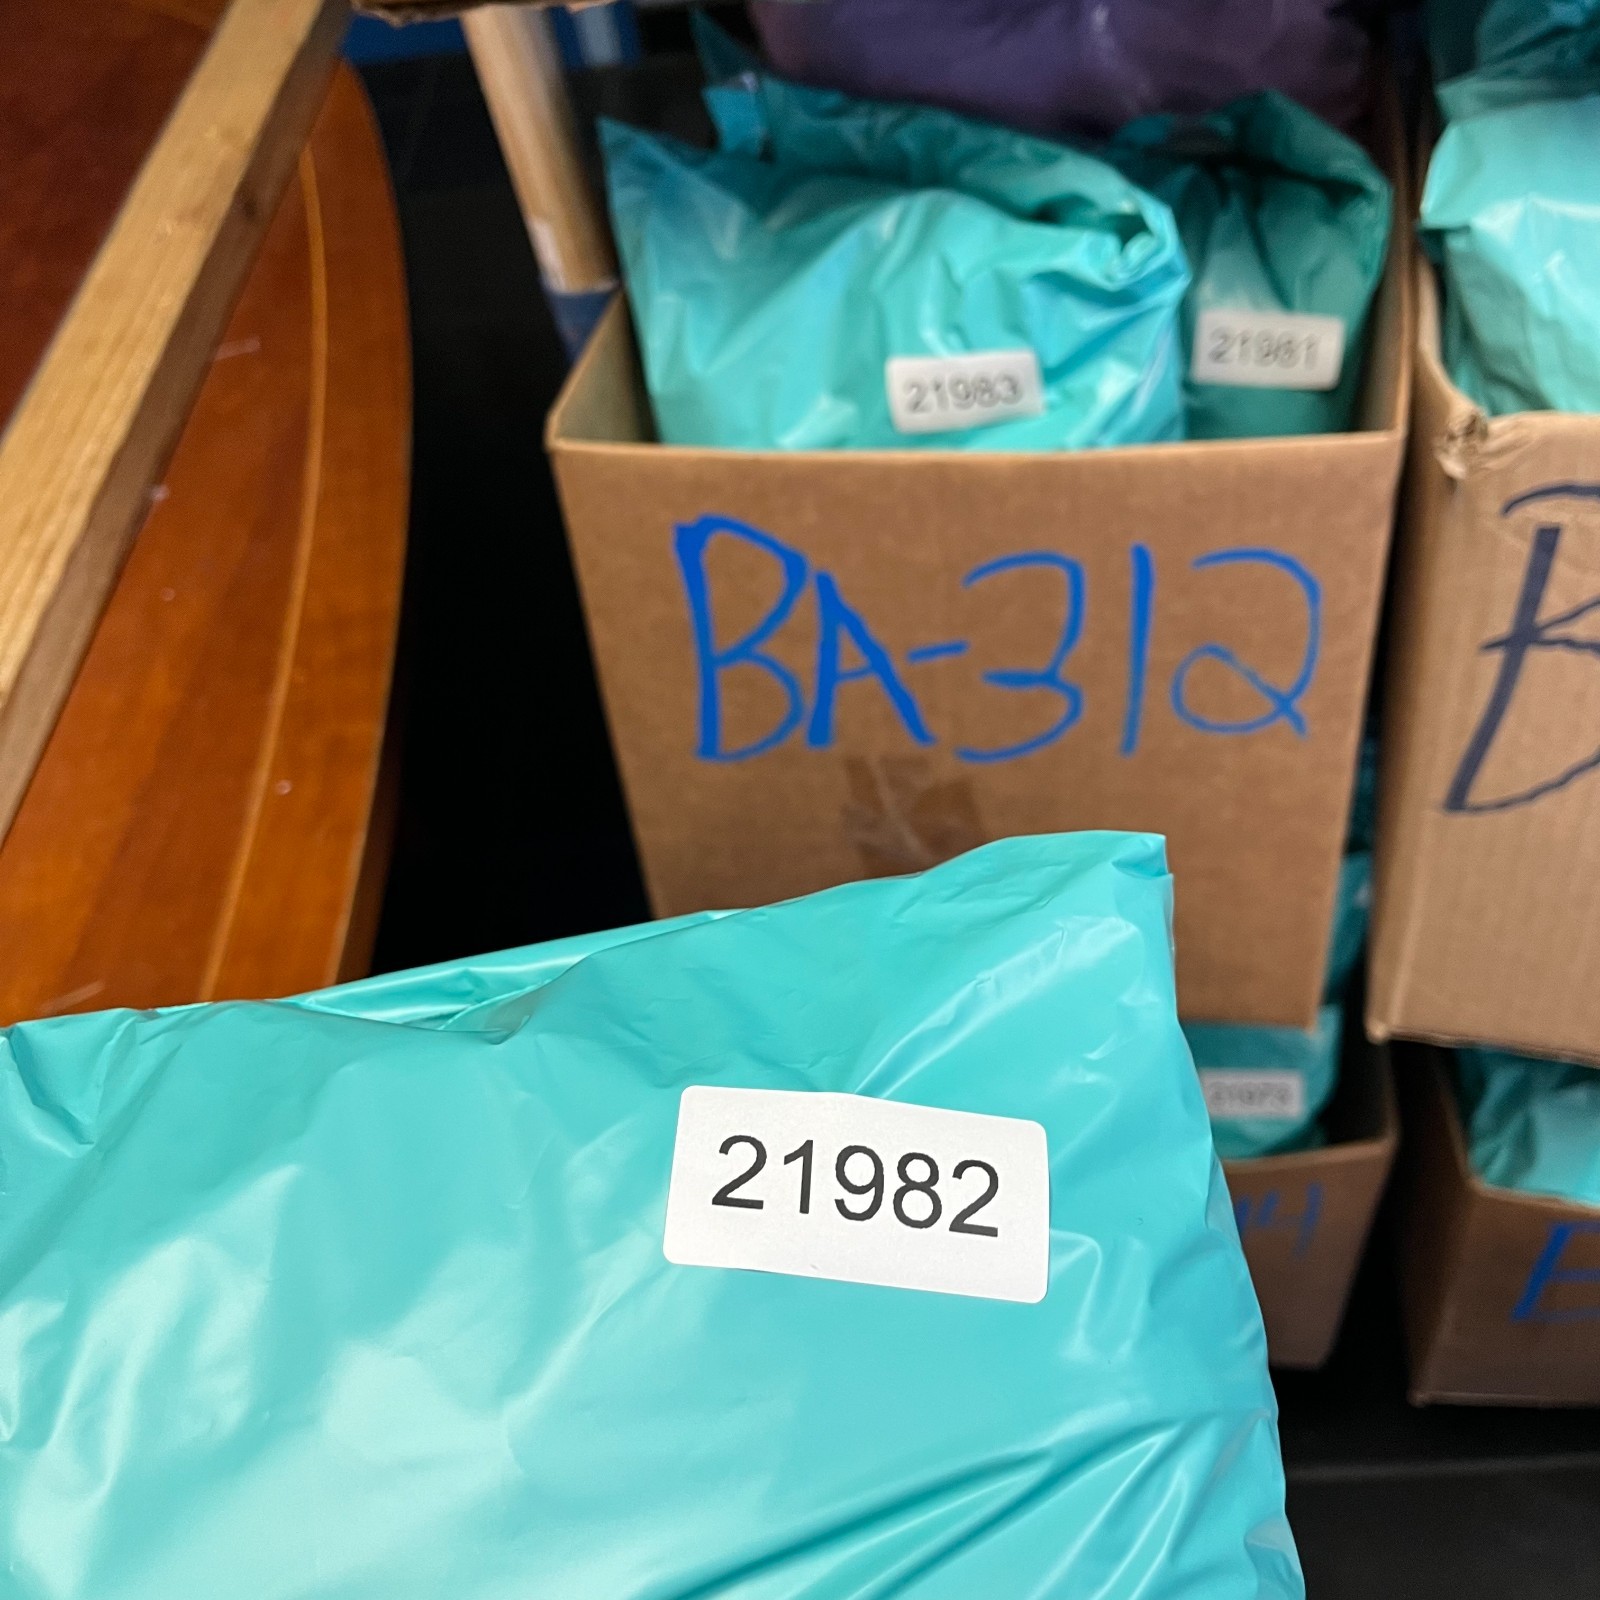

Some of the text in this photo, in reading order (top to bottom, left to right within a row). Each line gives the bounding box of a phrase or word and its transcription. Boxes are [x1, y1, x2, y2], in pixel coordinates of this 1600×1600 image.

[1208, 328, 1321, 371] 21981
[902, 370, 1024, 414] 21983
[673, 513, 1323, 763] BA-312
[711, 1134, 999, 1238] 21982
